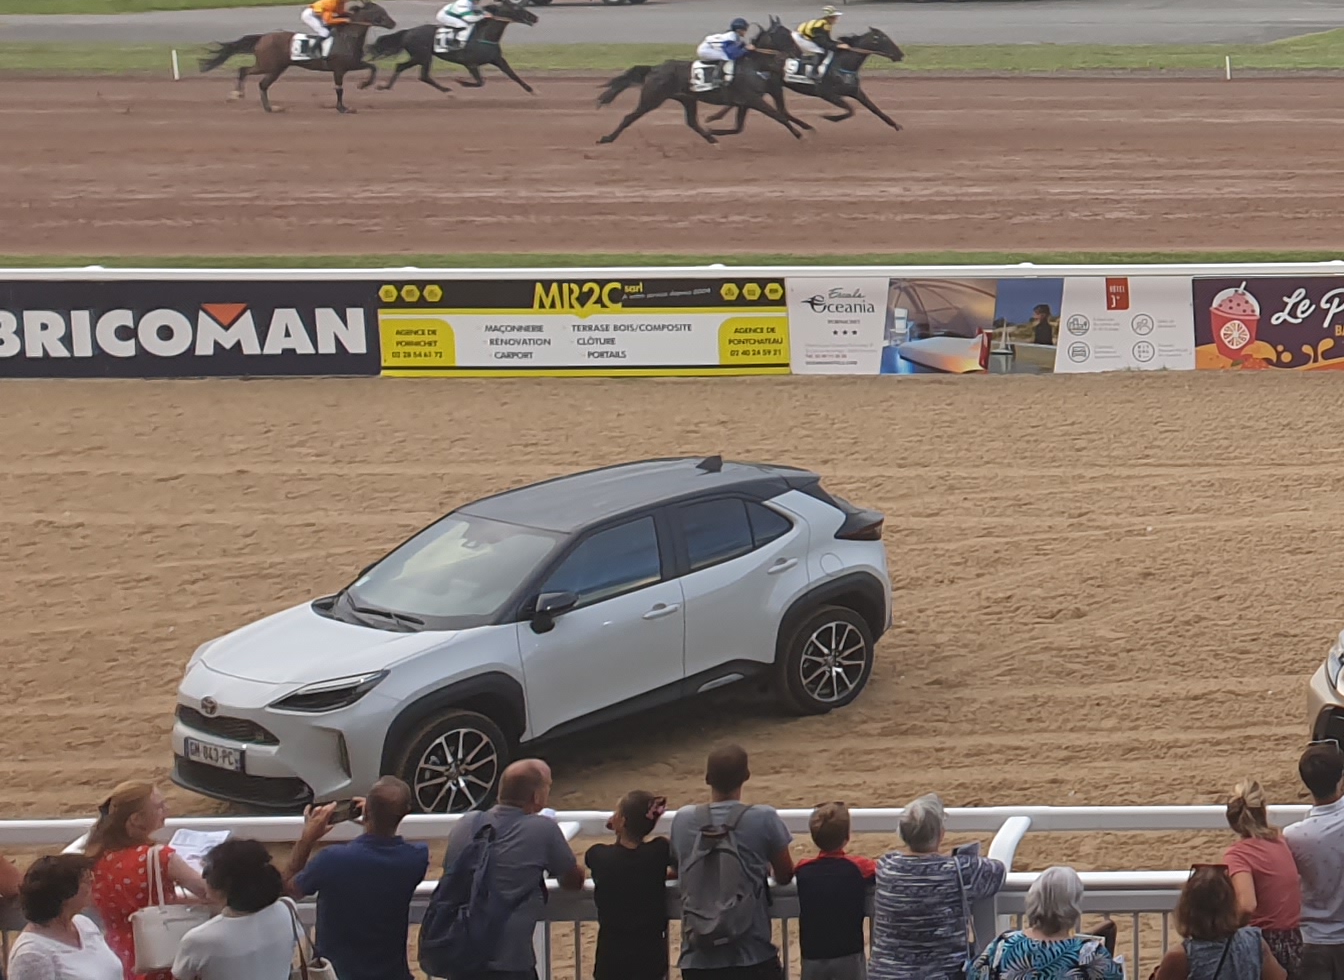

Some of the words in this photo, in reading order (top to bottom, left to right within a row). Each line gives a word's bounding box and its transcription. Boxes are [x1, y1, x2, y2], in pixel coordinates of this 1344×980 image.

[533, 281, 622, 310] MR2C
[808, 295, 875, 313] Oceania
[1270, 287, 1316, 325] Le
[613, 323, 692, 333] BOIS/COMPOSITE
[577, 336, 616, 345] CLÔTURE
[494, 351, 534, 359] CARPORT
[587, 351, 627, 359] PORTAILS
